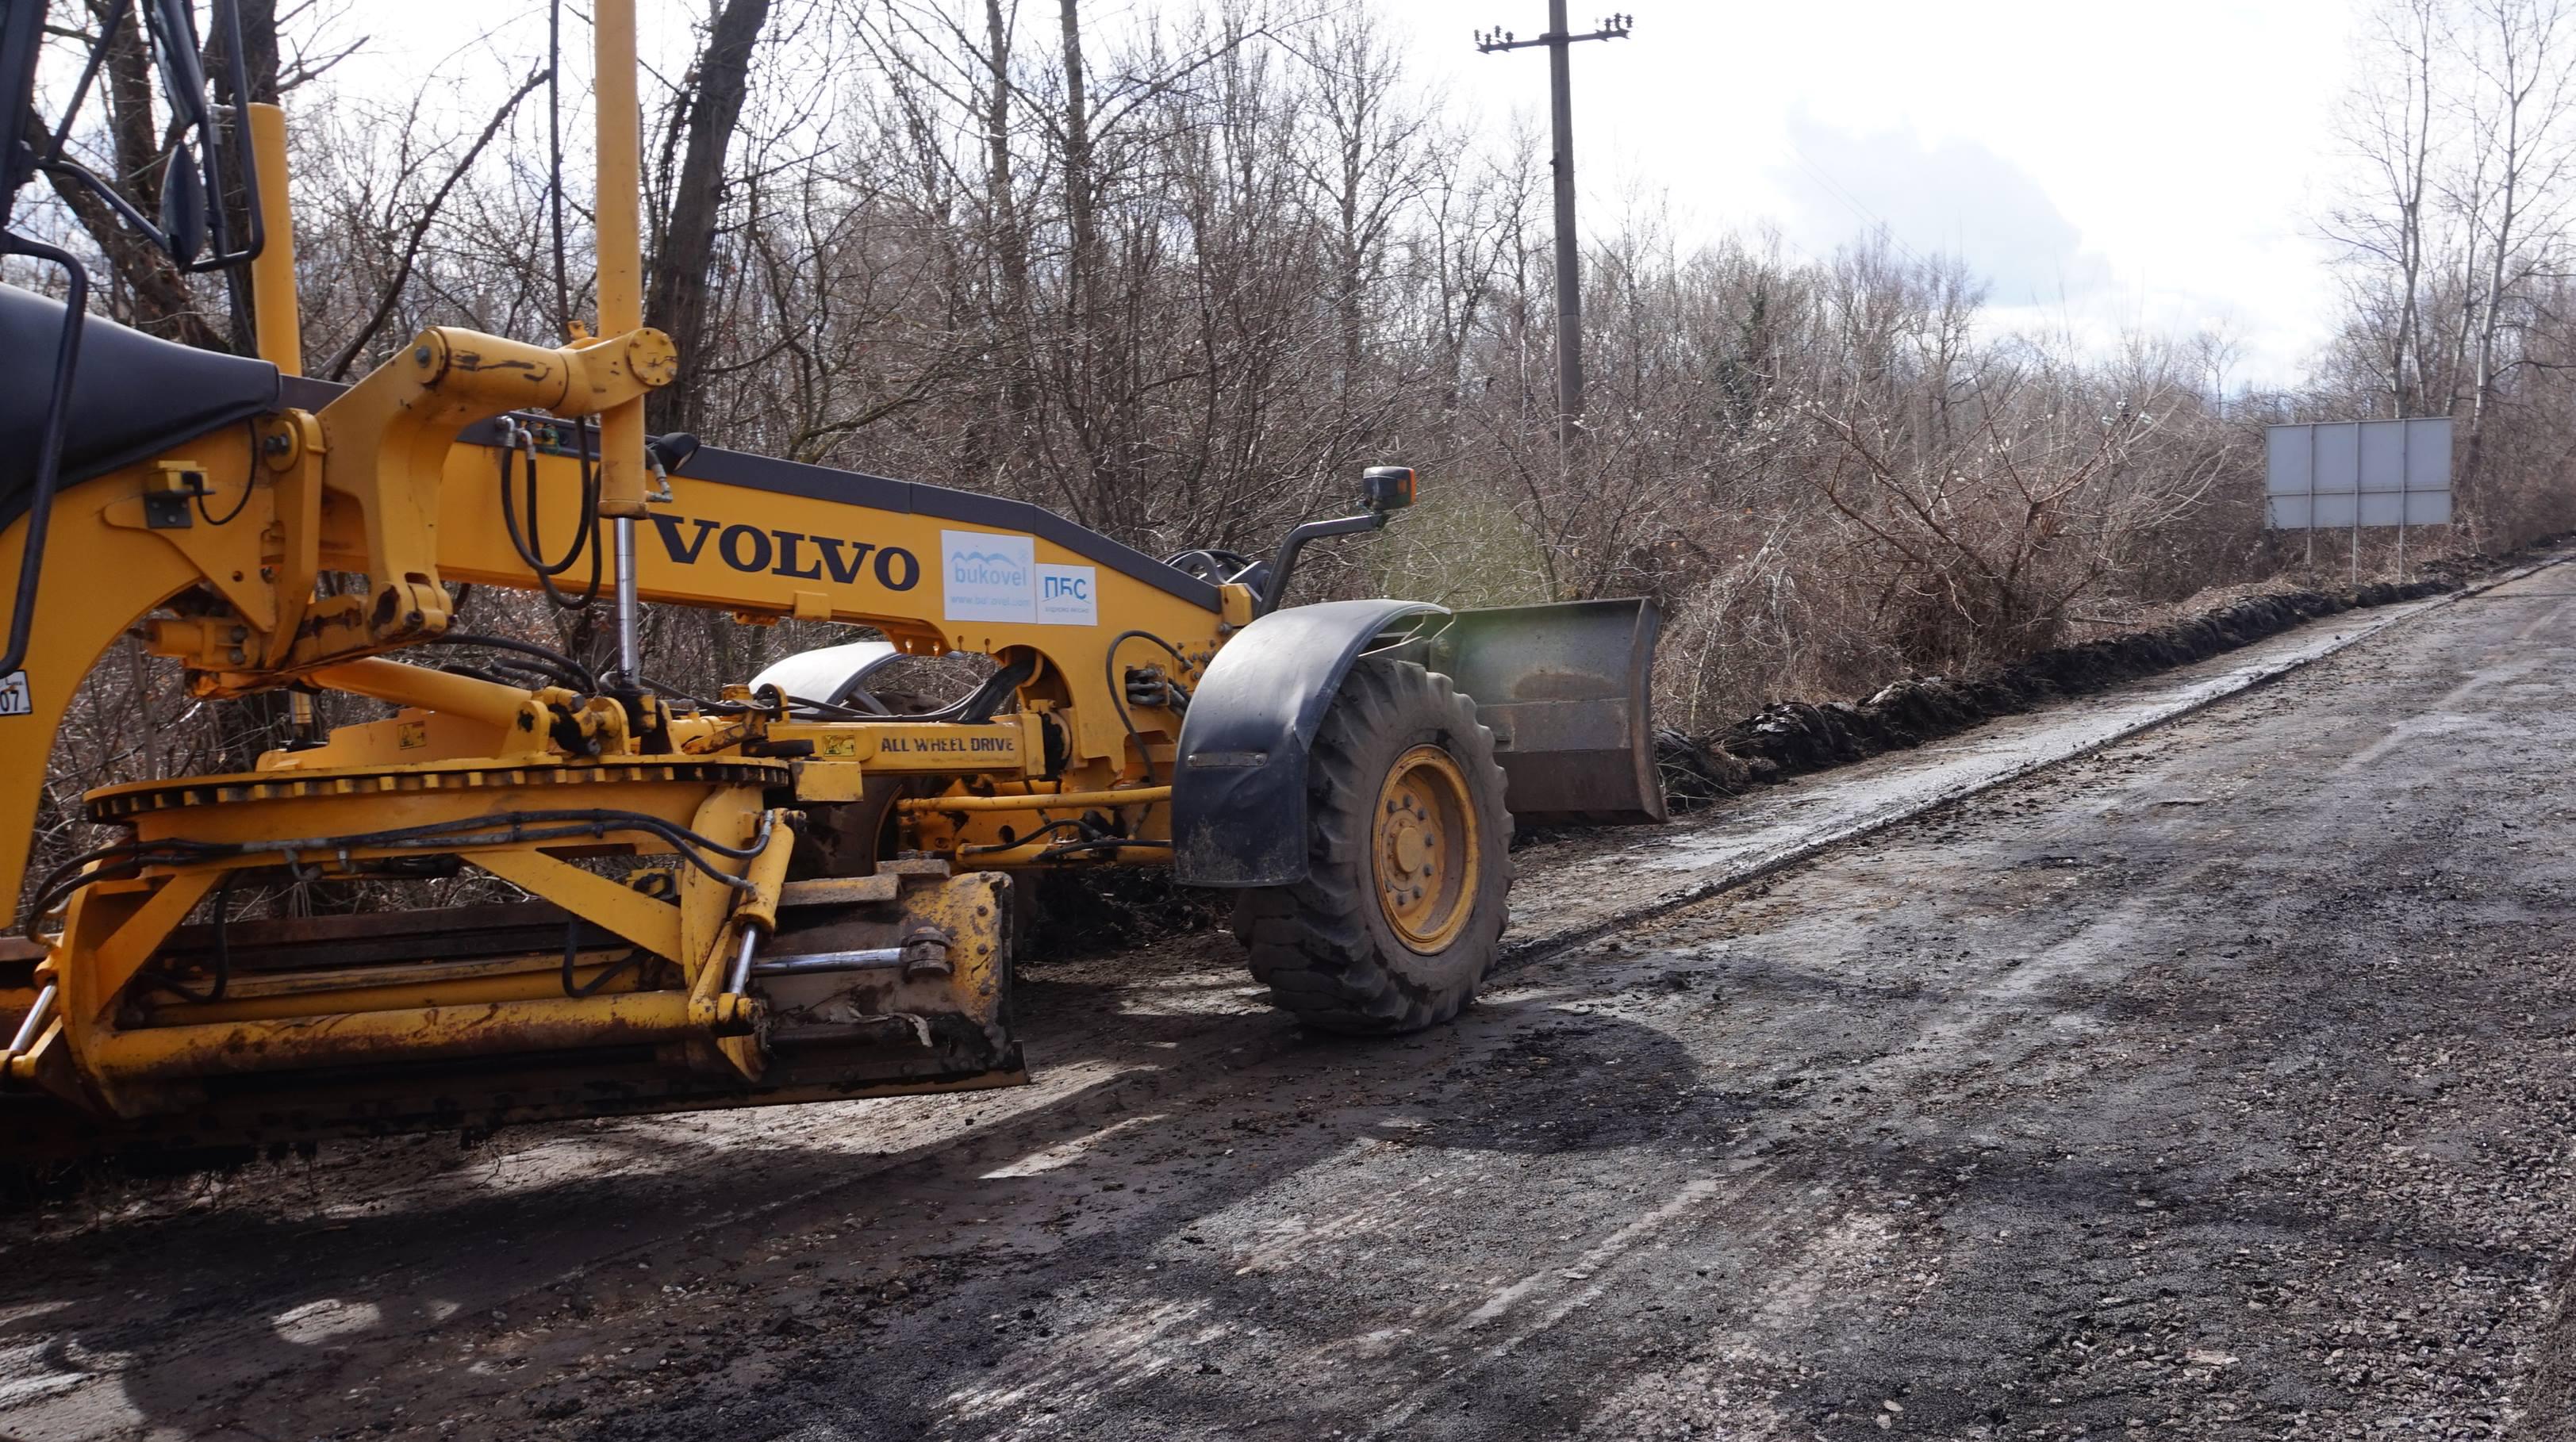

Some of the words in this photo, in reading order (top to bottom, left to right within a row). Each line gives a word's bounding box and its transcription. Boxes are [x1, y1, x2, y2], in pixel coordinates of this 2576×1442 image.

[648, 512, 921, 592] VOLVO
[954, 564, 1027, 586] bukovel
[950, 595, 1031, 608] www.buovel.com
[881, 738, 910, 752] ALL
[914, 738, 966, 752] WHEEL
[970, 738, 1015, 752] DRIVE
